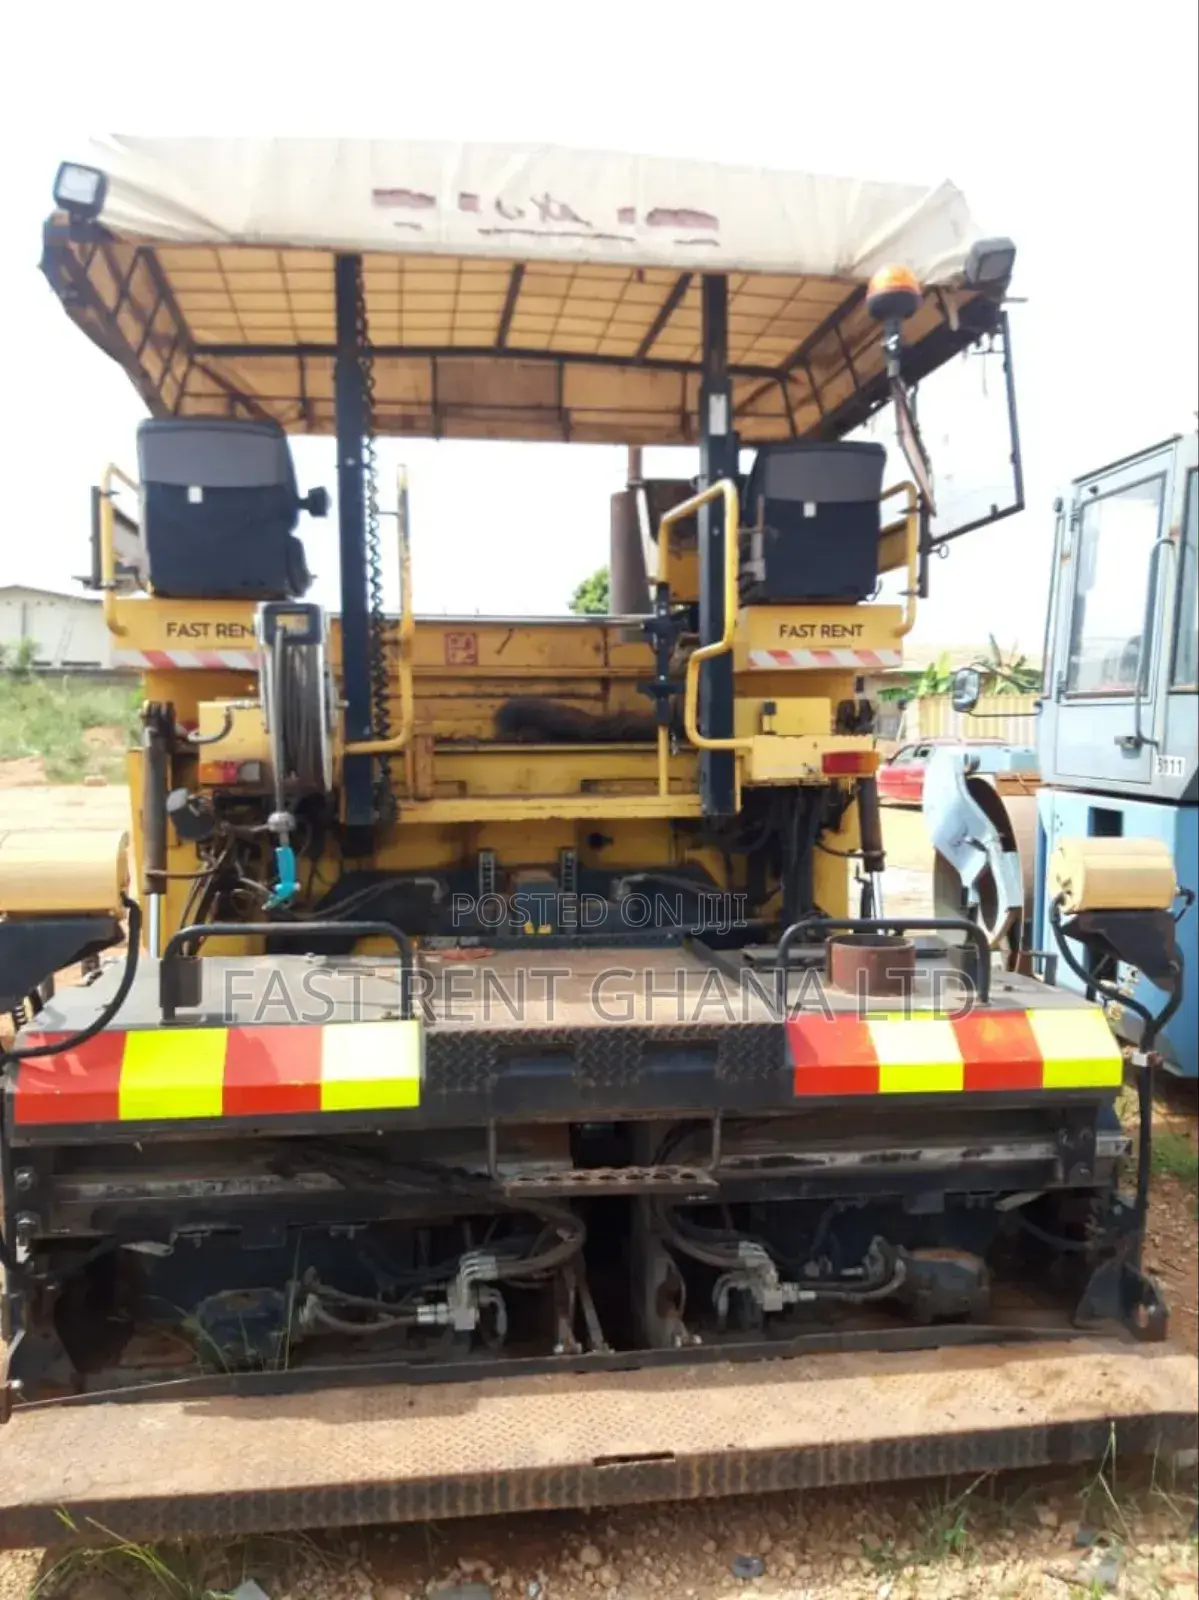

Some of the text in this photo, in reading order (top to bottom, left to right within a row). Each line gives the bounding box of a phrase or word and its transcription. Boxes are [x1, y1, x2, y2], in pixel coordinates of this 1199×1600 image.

[166, 622, 255, 639] FAST REN
[779, 623, 864, 638] FAST RENT
